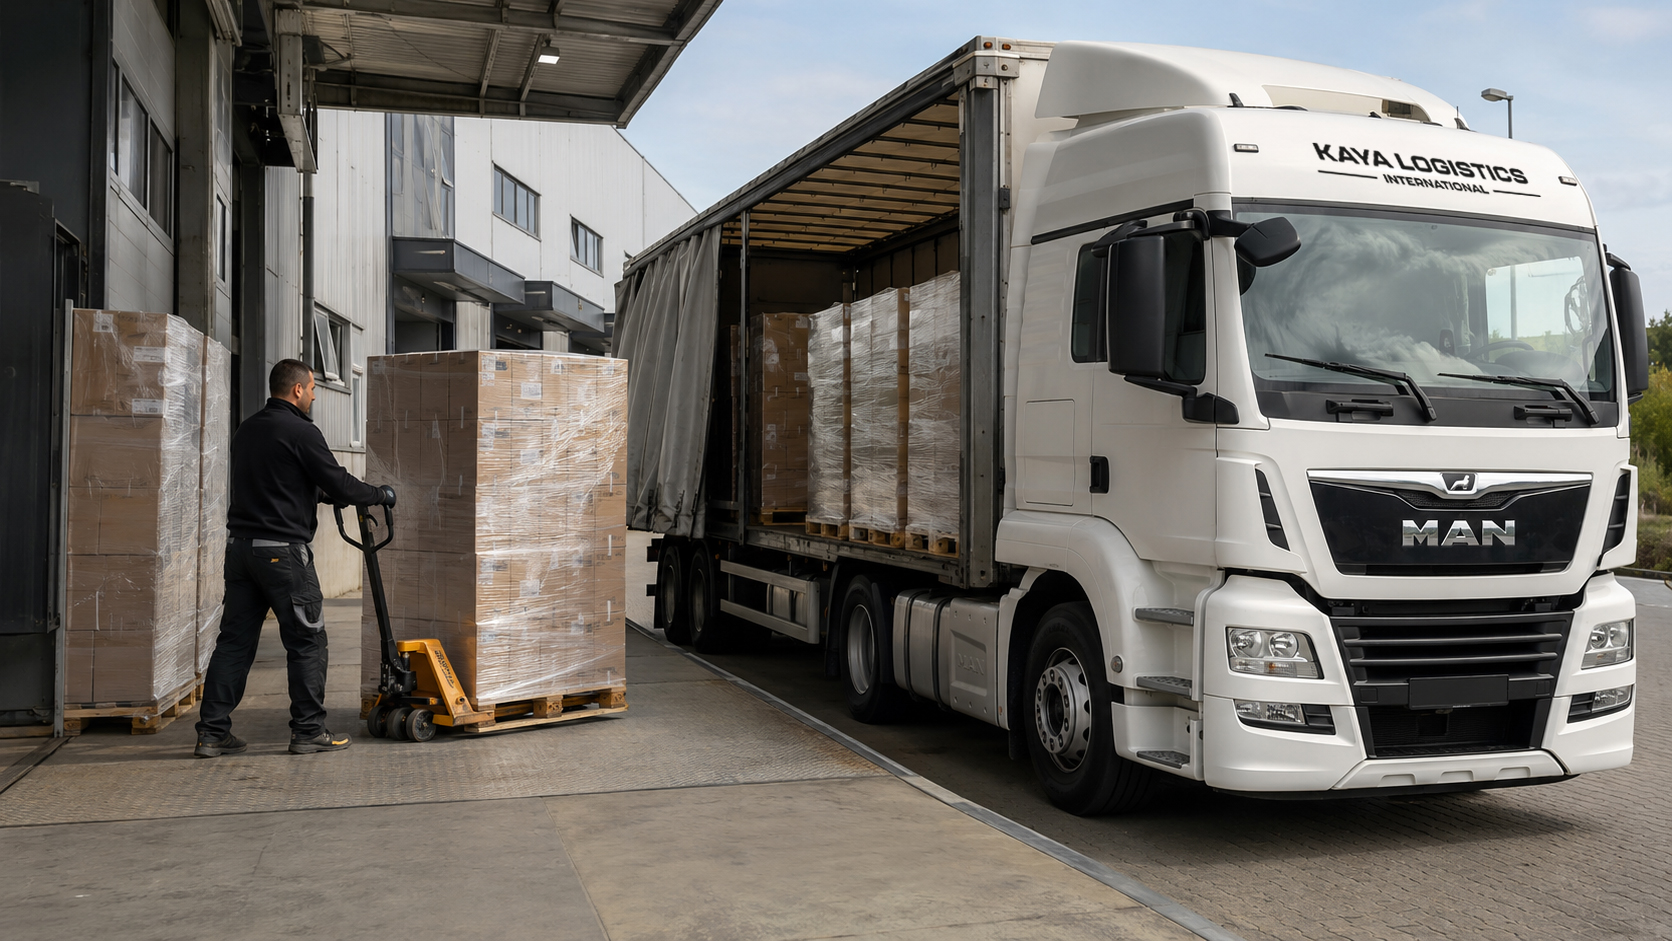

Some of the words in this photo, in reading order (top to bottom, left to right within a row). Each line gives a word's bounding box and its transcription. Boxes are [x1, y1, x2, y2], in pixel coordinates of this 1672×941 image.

[1312, 142, 1394, 169] KAYA
[1394, 153, 1529, 185] LOGISTICS
[1383, 174, 1490, 194] INTERNATIONAL
[1402, 519, 1516, 546] MAN
[957, 653, 985, 675] MAN
